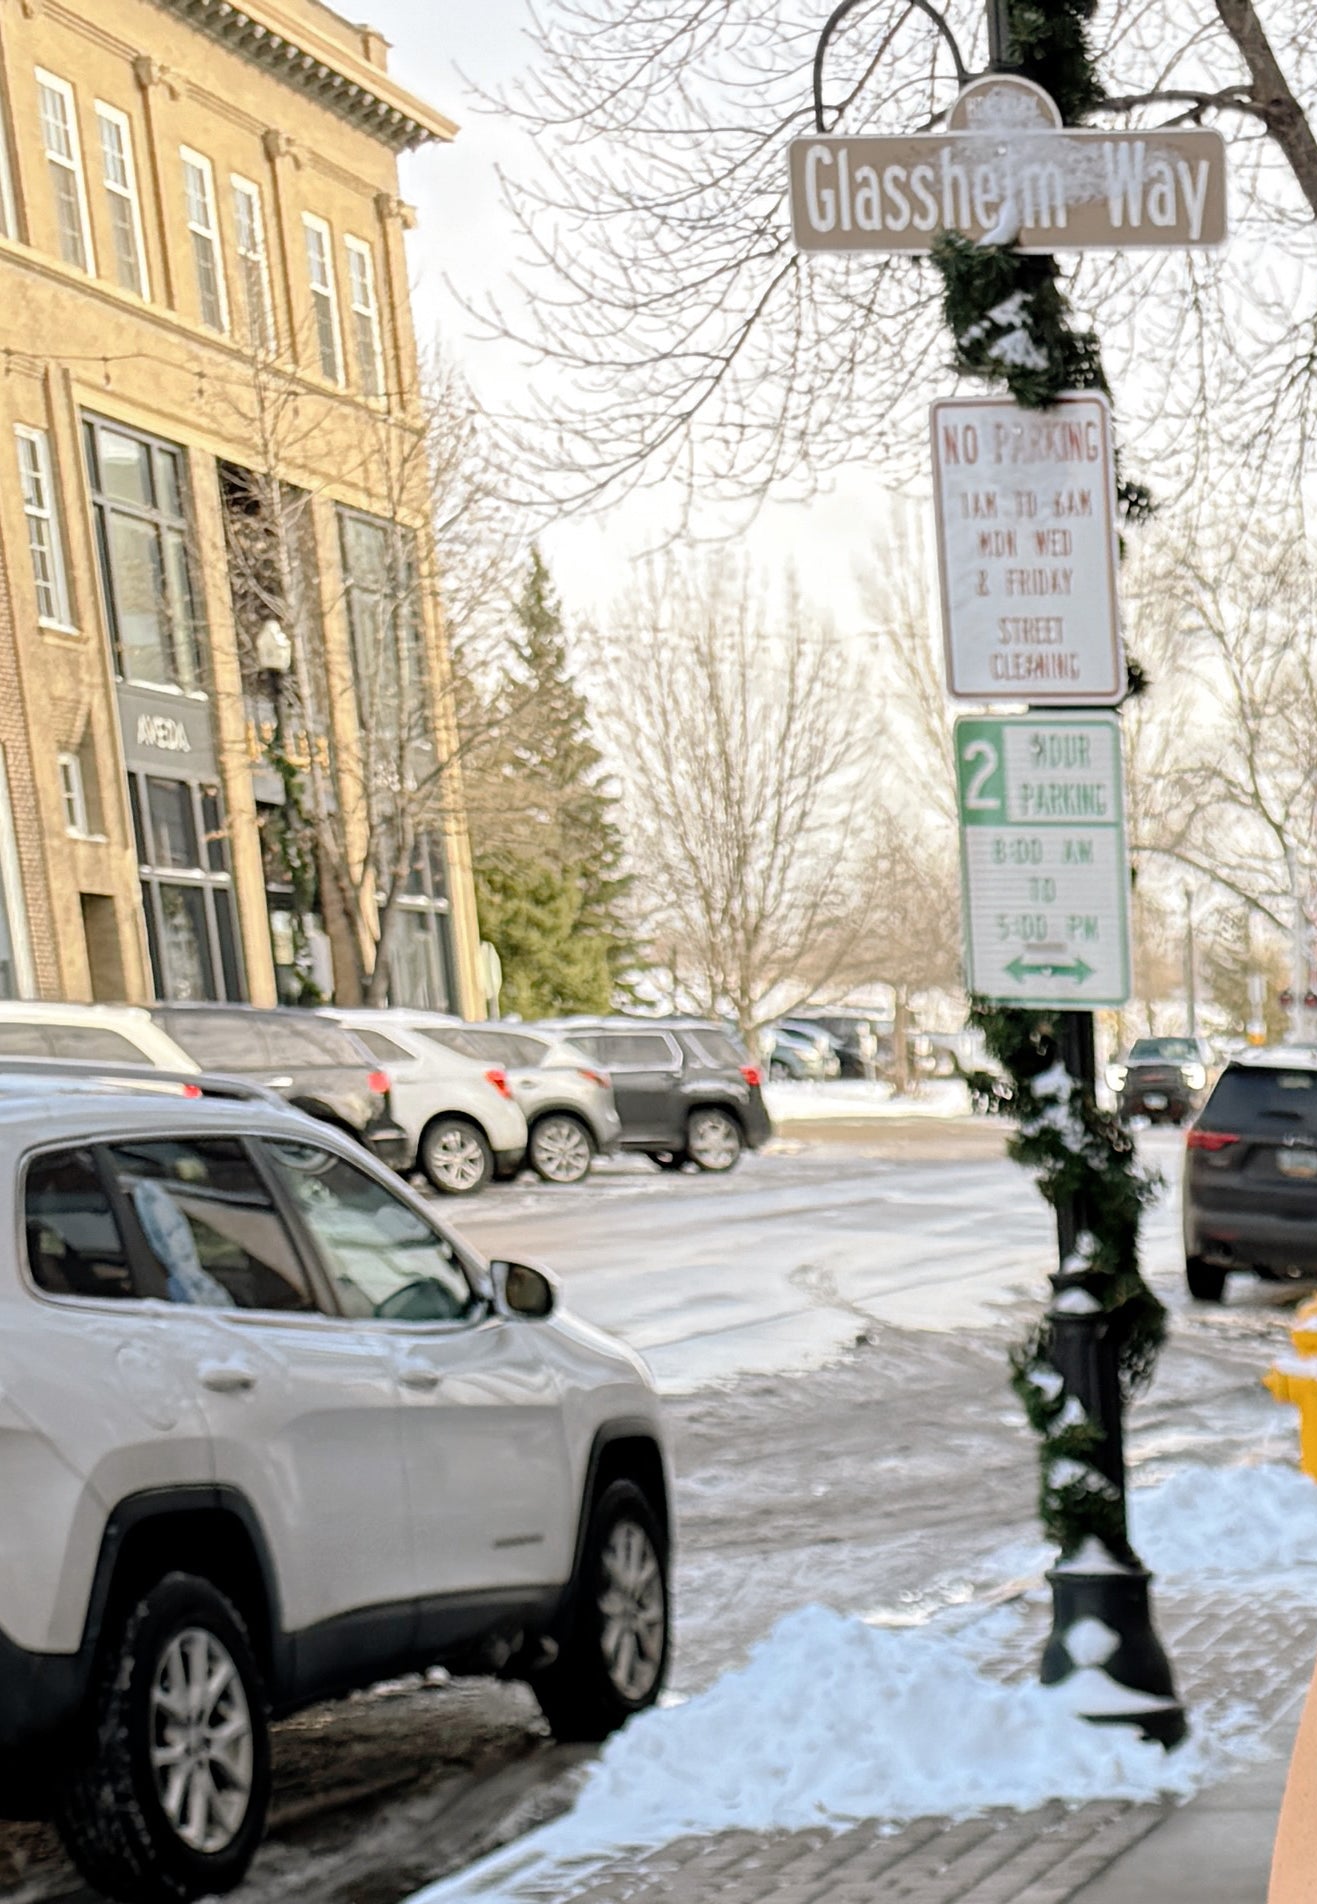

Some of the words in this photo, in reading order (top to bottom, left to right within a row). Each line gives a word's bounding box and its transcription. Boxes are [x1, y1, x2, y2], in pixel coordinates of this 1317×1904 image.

[1102, 139, 1211, 241] Way
[943, 424, 978, 465] NO
[994, 420, 1099, 464] PARKING
[978, 529, 1017, 557] MON
[1034, 528, 1072, 557] WED
[976, 568, 990, 596] &
[1005, 567, 1074, 596] FRIDAY
[998, 615, 1064, 645] STREET
[990, 652, 1081, 681] CLEANING
[963, 738, 1000, 809] 2
[1030, 733, 1091, 768] HOUR
[1021, 783, 1107, 817] PARKING
[1061, 838, 1094, 864] AM
[1030, 877, 1057, 903] TO
[997, 914, 1048, 941] 5:00
[1066, 915, 1099, 941] PM
